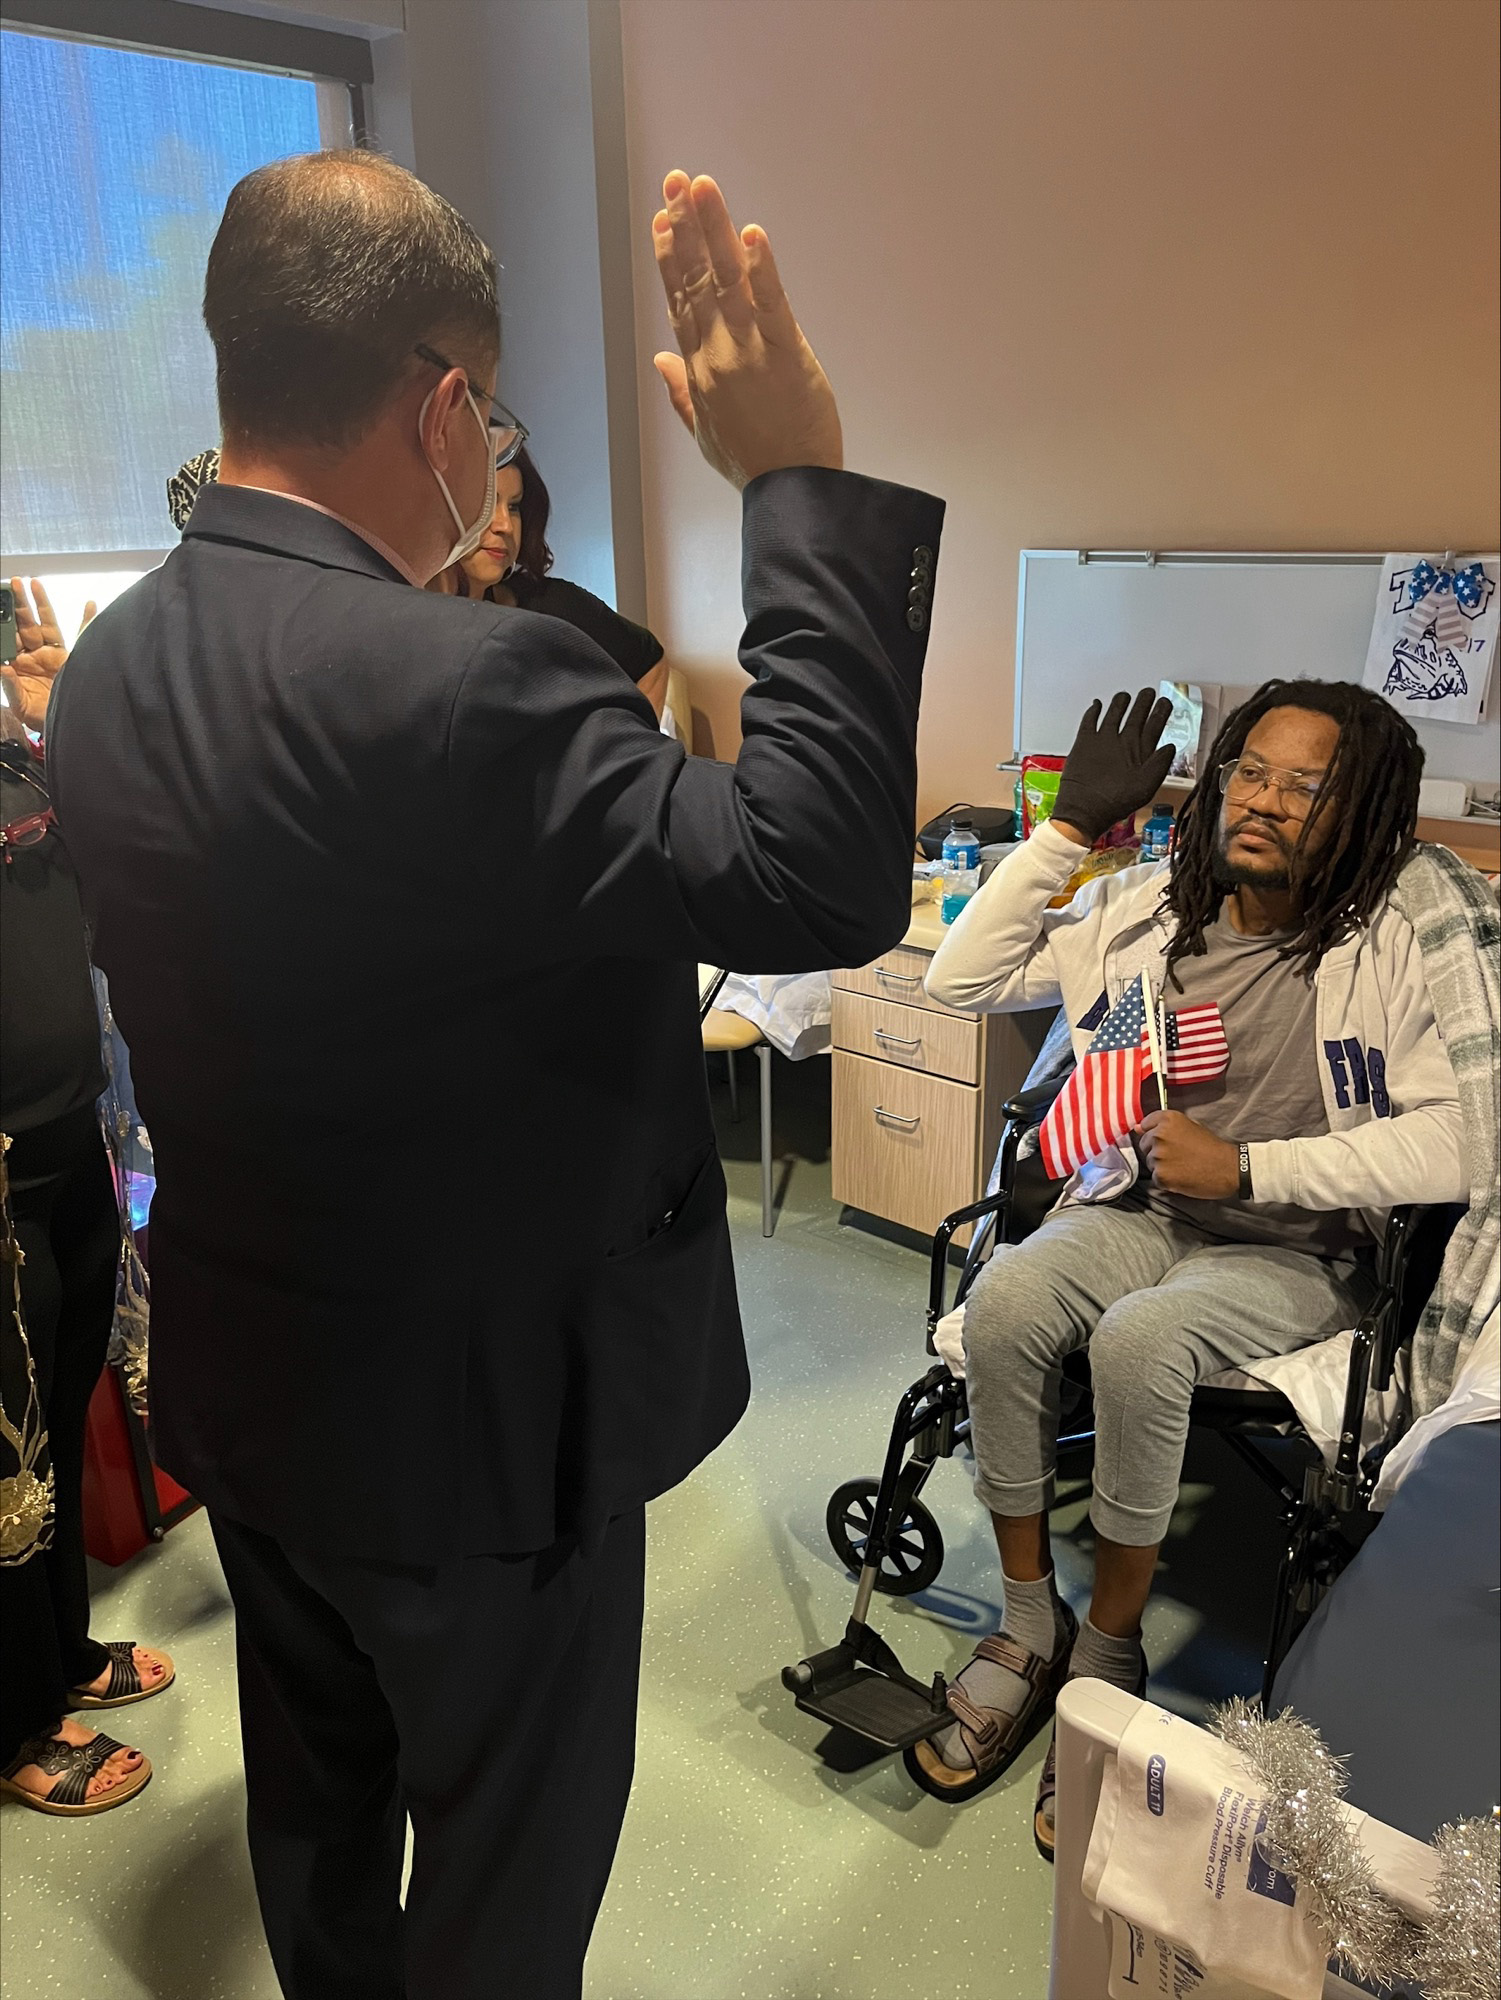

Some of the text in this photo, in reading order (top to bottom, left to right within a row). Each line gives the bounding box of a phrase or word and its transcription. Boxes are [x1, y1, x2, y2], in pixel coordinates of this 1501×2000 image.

[1389, 566, 1496, 620] TU
[1240, 1153, 1249, 1172] GOD
[1150, 1757, 1162, 1812] ADULT 11
[1204, 1786, 1233, 1890] Blood Pressure Cuff
[1240, 1797, 1258, 1831] Welch
[1214, 1844, 1232, 1900] Disposable
